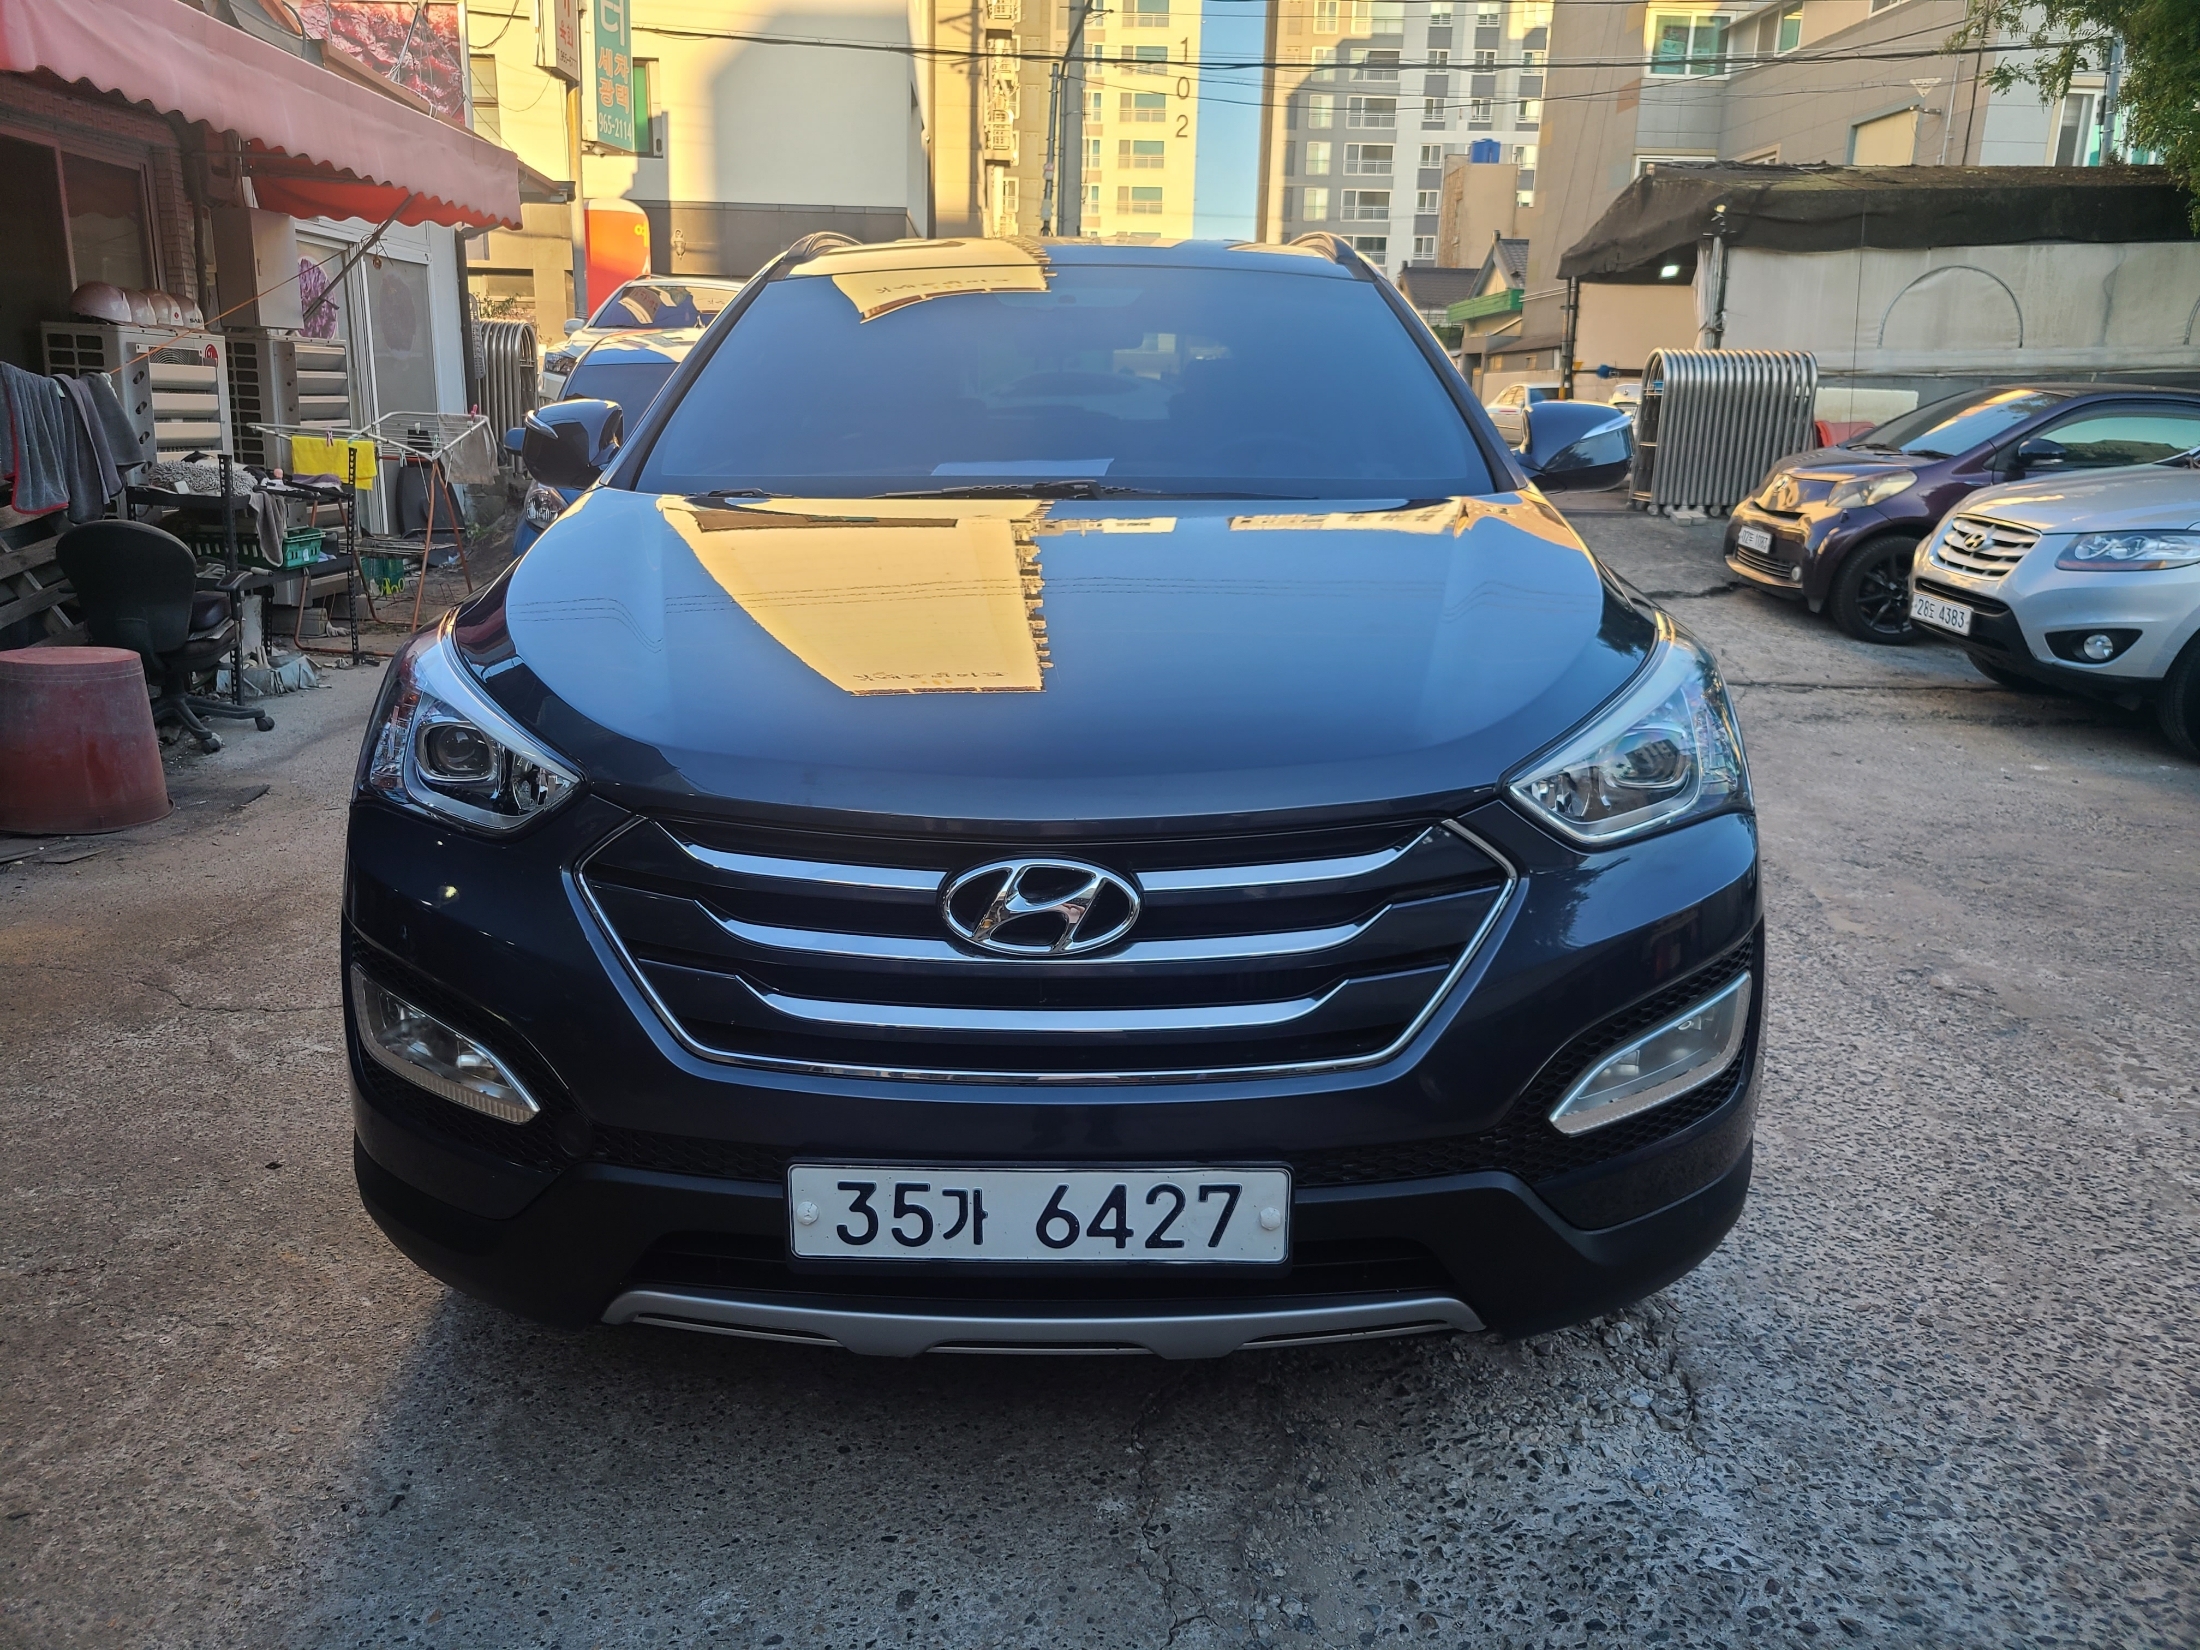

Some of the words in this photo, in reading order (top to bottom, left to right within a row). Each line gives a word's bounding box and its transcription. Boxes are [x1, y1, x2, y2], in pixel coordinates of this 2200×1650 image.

[597, 46, 630, 84] 세차
[598, 77, 630, 115] 광택
[1174, 36, 1191, 139] 102
[598, 112, 632, 142] 965-2114
[1916, 598, 1935, 619] 28도
[1938, 605, 1966, 629] 4383
[836, 1181, 989, 1247] 35가
[1035, 1183, 1244, 1249] 6427
